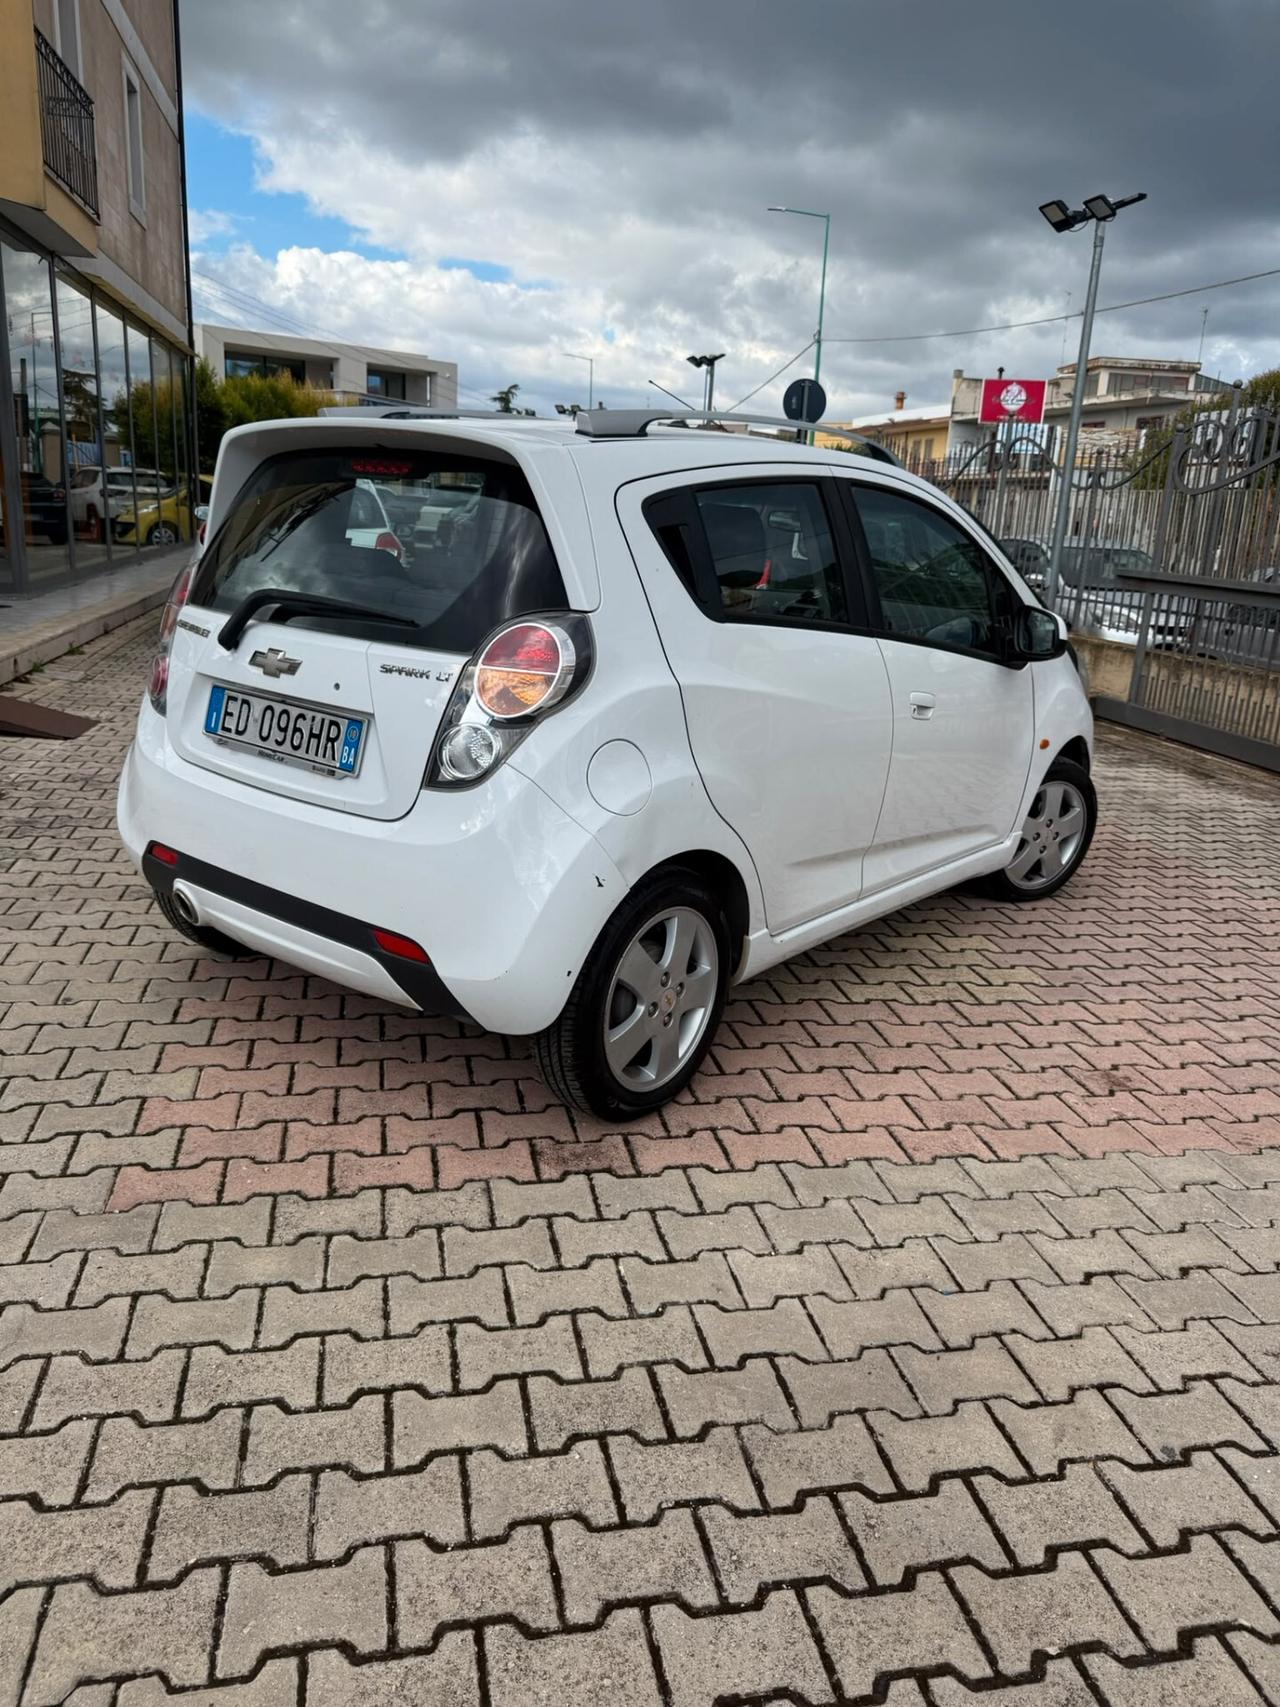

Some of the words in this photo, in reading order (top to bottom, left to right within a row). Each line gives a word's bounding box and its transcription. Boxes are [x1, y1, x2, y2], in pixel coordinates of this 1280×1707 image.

[379, 663, 431, 680] SPARK
[435, 671, 454, 682] LT
[220, 694, 251, 736] ED
[258, 704, 342, 761] 096HR
[341, 746, 355, 765] BA
